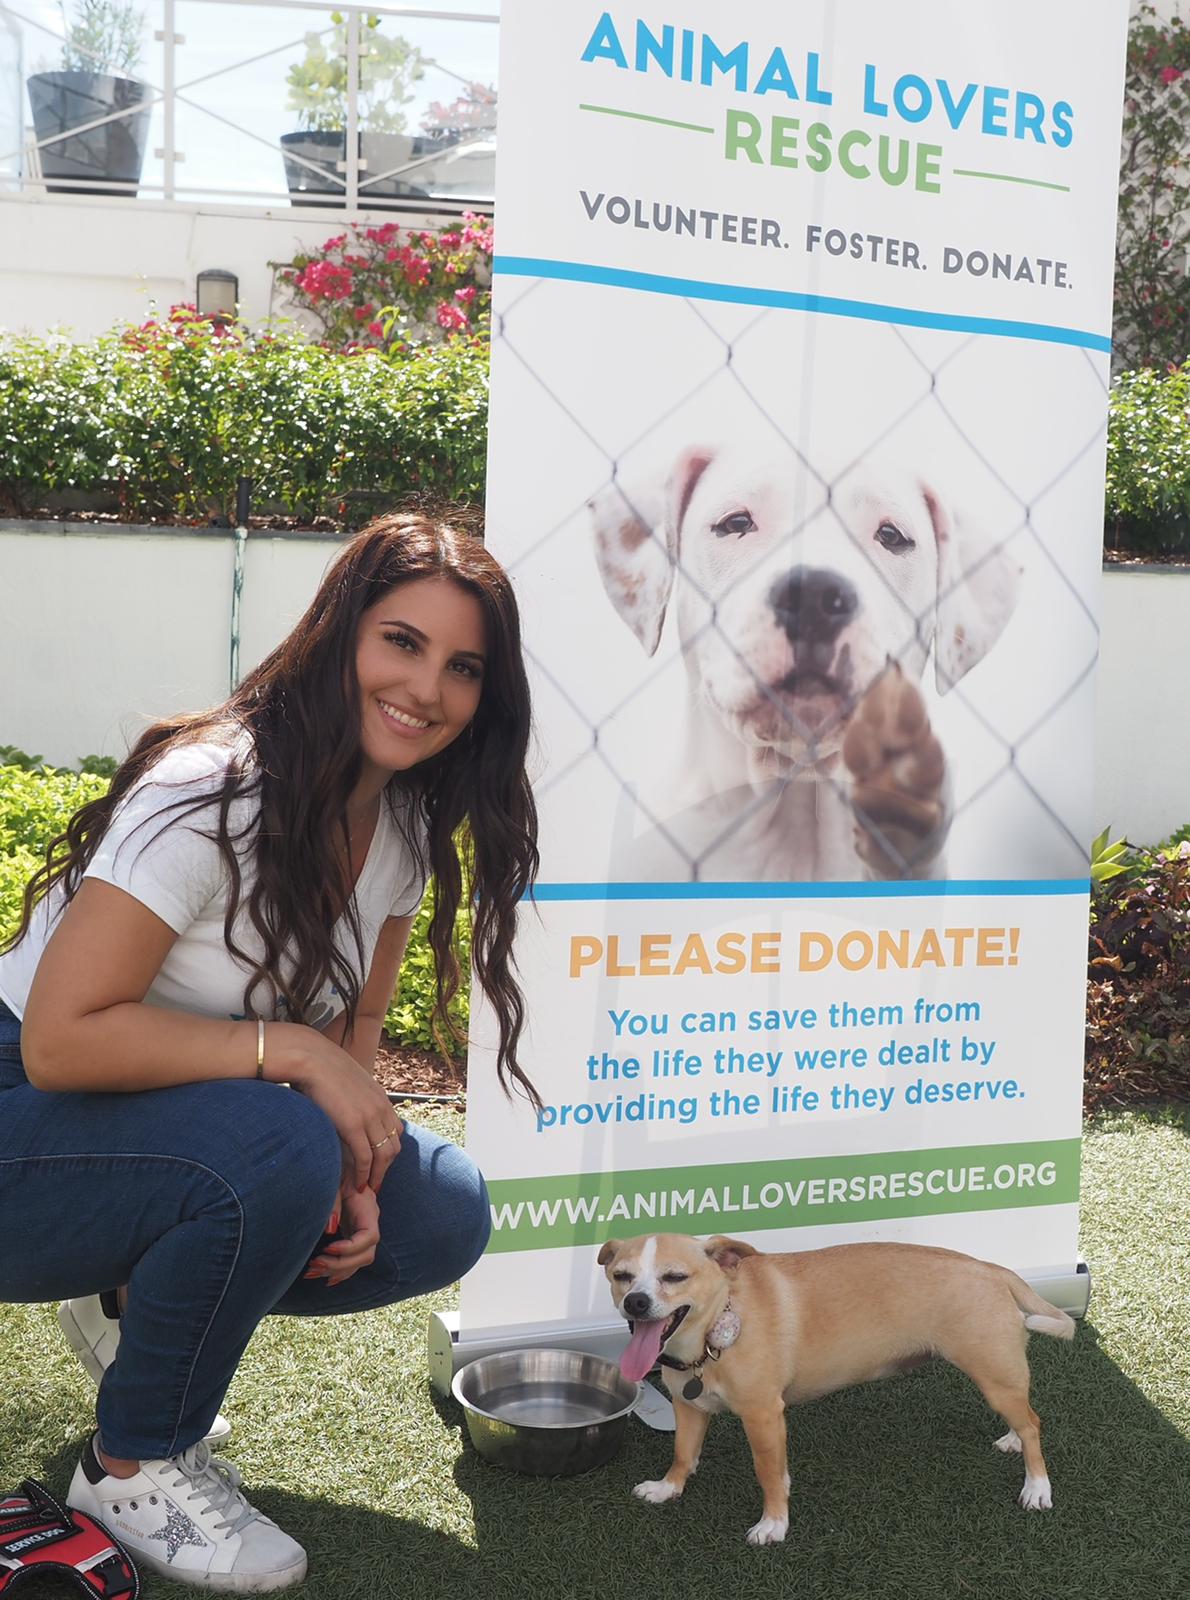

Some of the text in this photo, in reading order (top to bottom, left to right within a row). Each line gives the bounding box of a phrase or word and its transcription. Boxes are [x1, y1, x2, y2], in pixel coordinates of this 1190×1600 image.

[581, 12, 1074, 149] ANIMAL LOVERS
[724, 108, 943, 194] RESCUE
[579, 190, 1073, 289] VOLUNTEER. FOSTER. DONATE.
[570, 927, 1021, 978] PLEASE DONATE!
[608, 997, 981, 1036] You can save them from
[587, 1036, 996, 1082] the life they were dealt by
[536, 1078, 1025, 1132] providing the life they deserve.
[489, 1161, 1057, 1231] WWW.ANIMALLOVERSRESCUE.ORG
[5, 1534, 45, 1552] SERVICE
